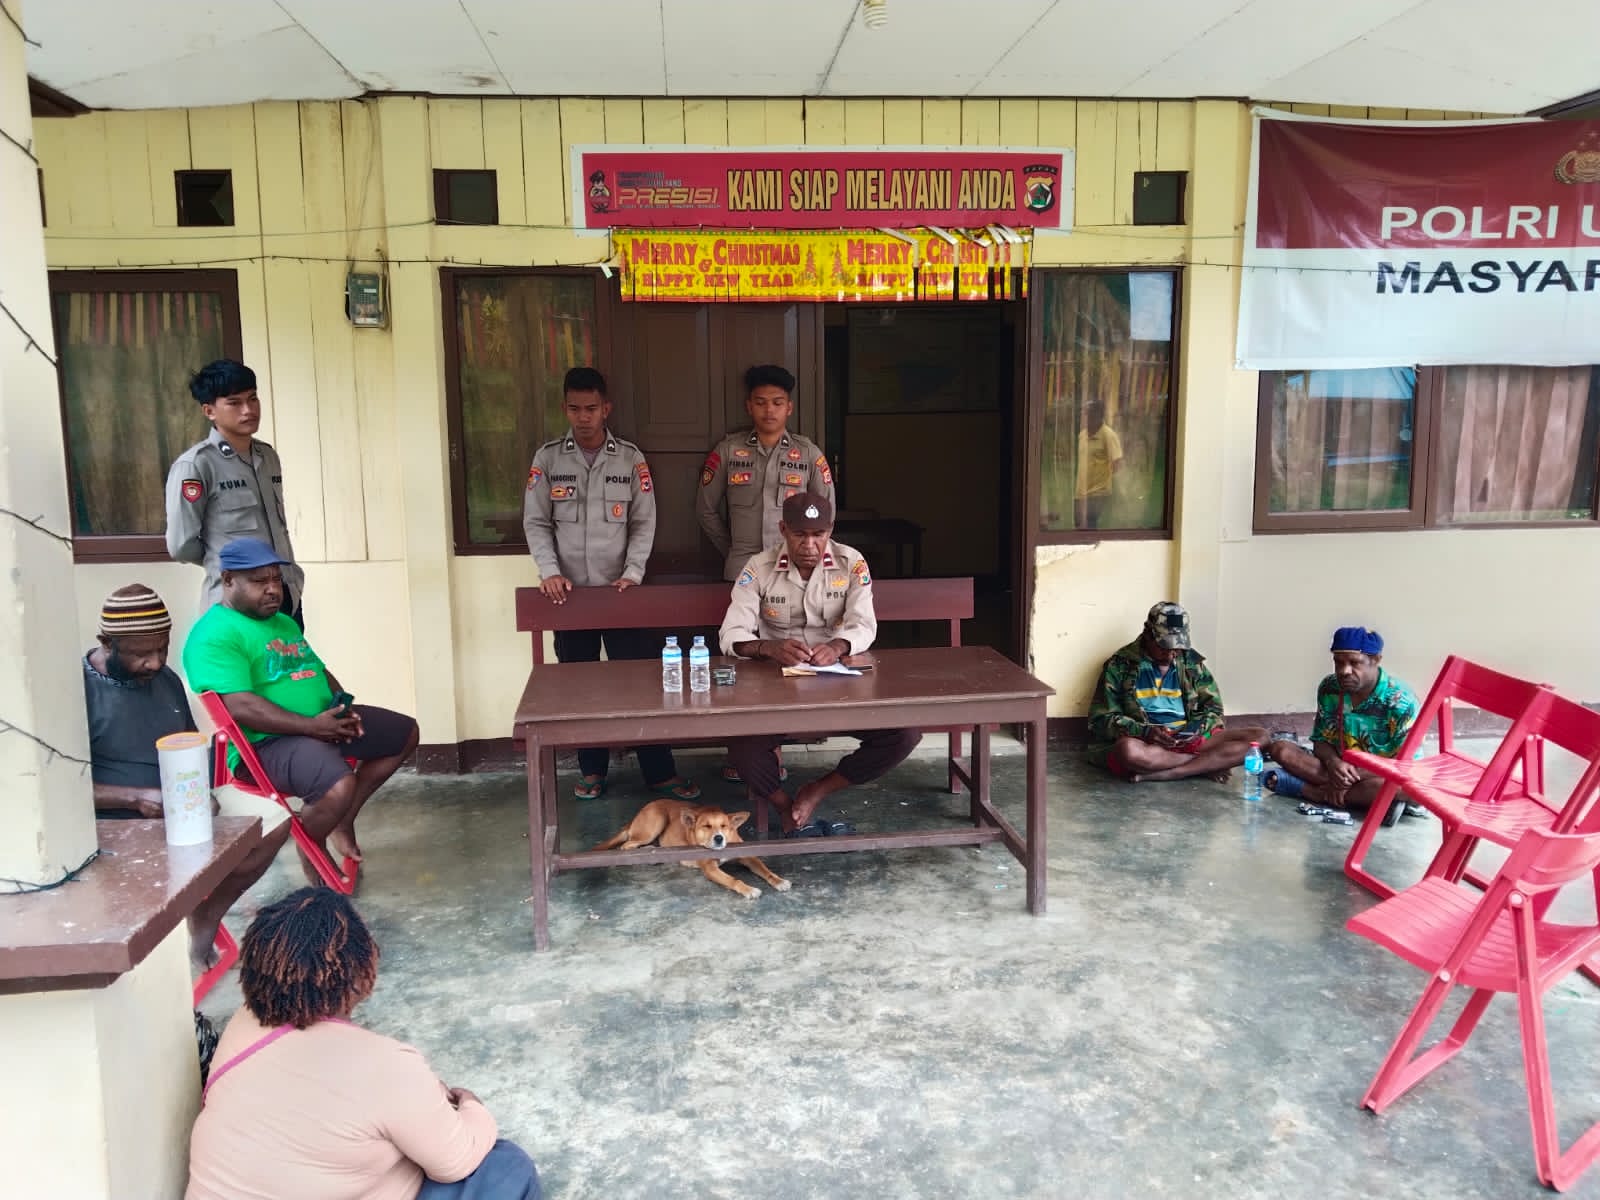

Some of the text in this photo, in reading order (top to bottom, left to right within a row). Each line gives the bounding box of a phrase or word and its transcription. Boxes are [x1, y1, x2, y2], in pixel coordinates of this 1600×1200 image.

[619, 187, 719, 205] PRESISI
[727, 169, 1017, 212] KAMI SIAP MELAYANI ANDA
[1381, 205, 1559, 240] POLRI
[632, 238, 698, 265] MERRY
[713, 239, 800, 265] CHRISTMAS
[847, 239, 912, 265] MERRY
[642, 273, 794, 288] HAPPY NEW YEAR
[780, 461, 808, 471] POLRI
[219, 479, 248, 491] KUNA
[605, 475, 631, 484] POLRI
